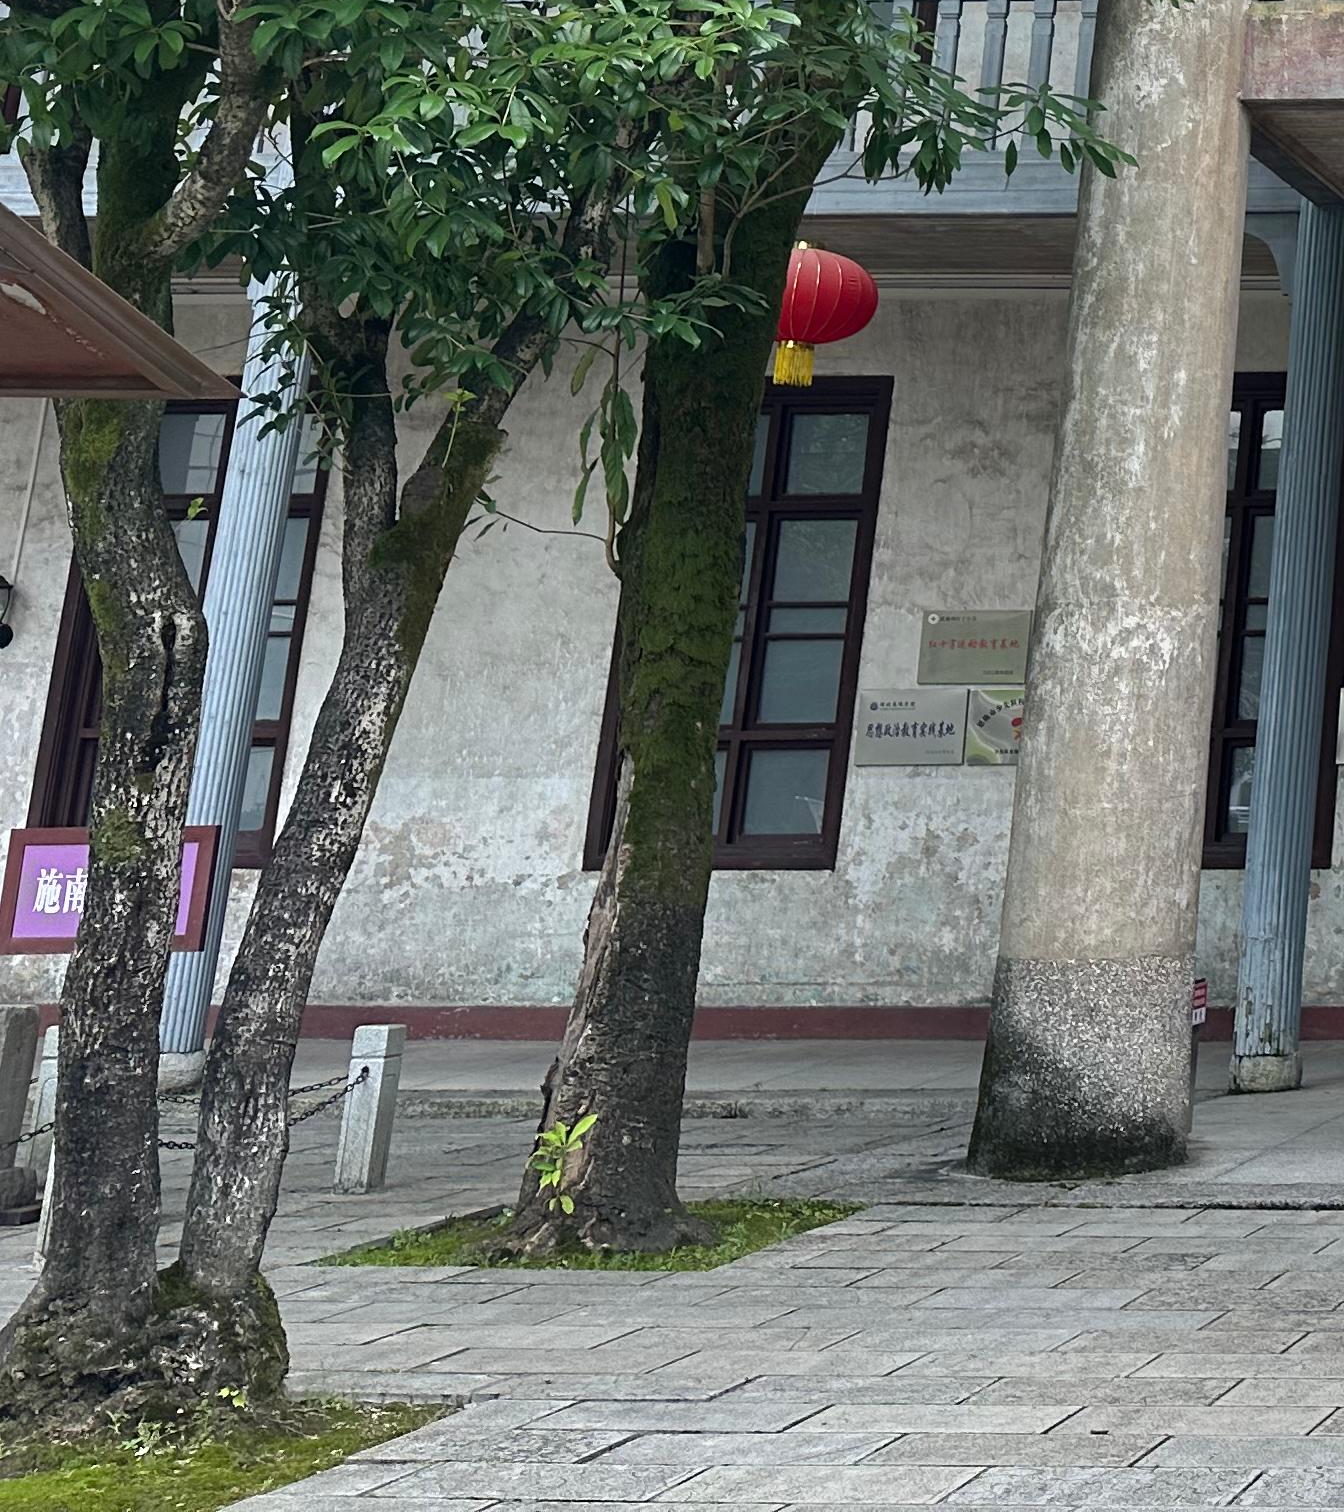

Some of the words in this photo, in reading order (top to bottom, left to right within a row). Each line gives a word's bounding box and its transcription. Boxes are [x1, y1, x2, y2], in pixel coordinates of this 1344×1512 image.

[865, 719, 956, 739] 思想政治教育实践基地
